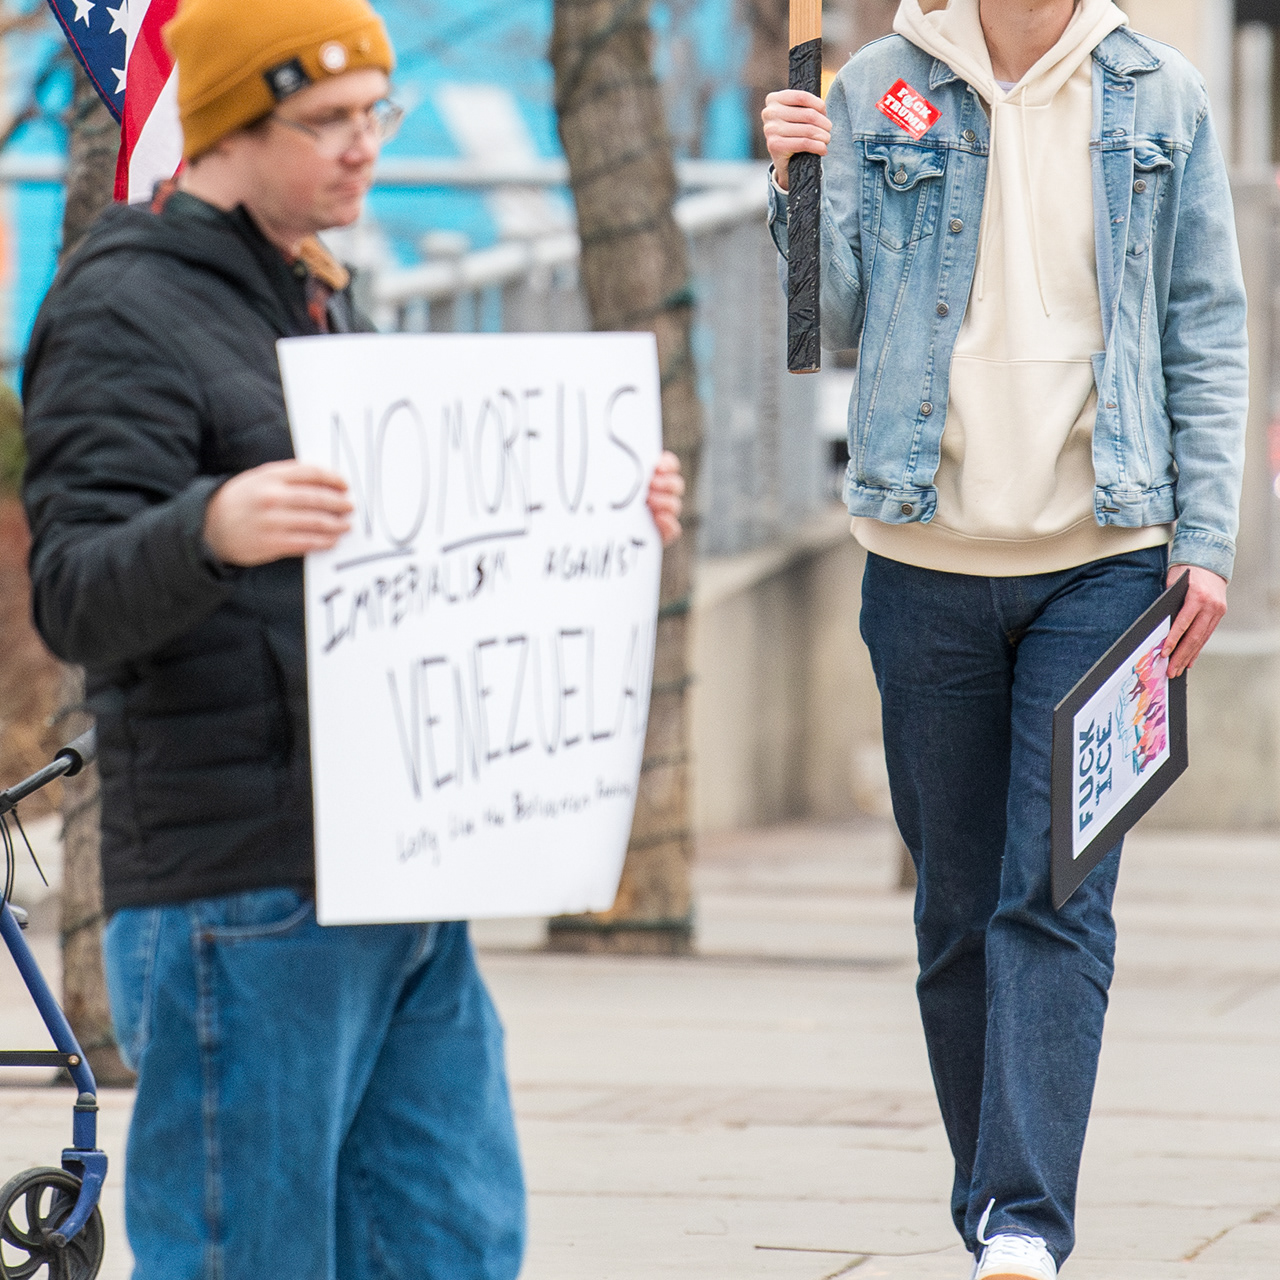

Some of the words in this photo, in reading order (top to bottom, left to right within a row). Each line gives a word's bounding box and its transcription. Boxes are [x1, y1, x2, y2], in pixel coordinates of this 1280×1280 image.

[884, 94, 927, 131] TRUMP
[330, 396, 431, 548] NO
[435, 384, 546, 536] MORE
[542, 536, 647, 582] AGAINST
[1078, 718, 1095, 832] FUCK
[1095, 711, 1113, 807] ICE
